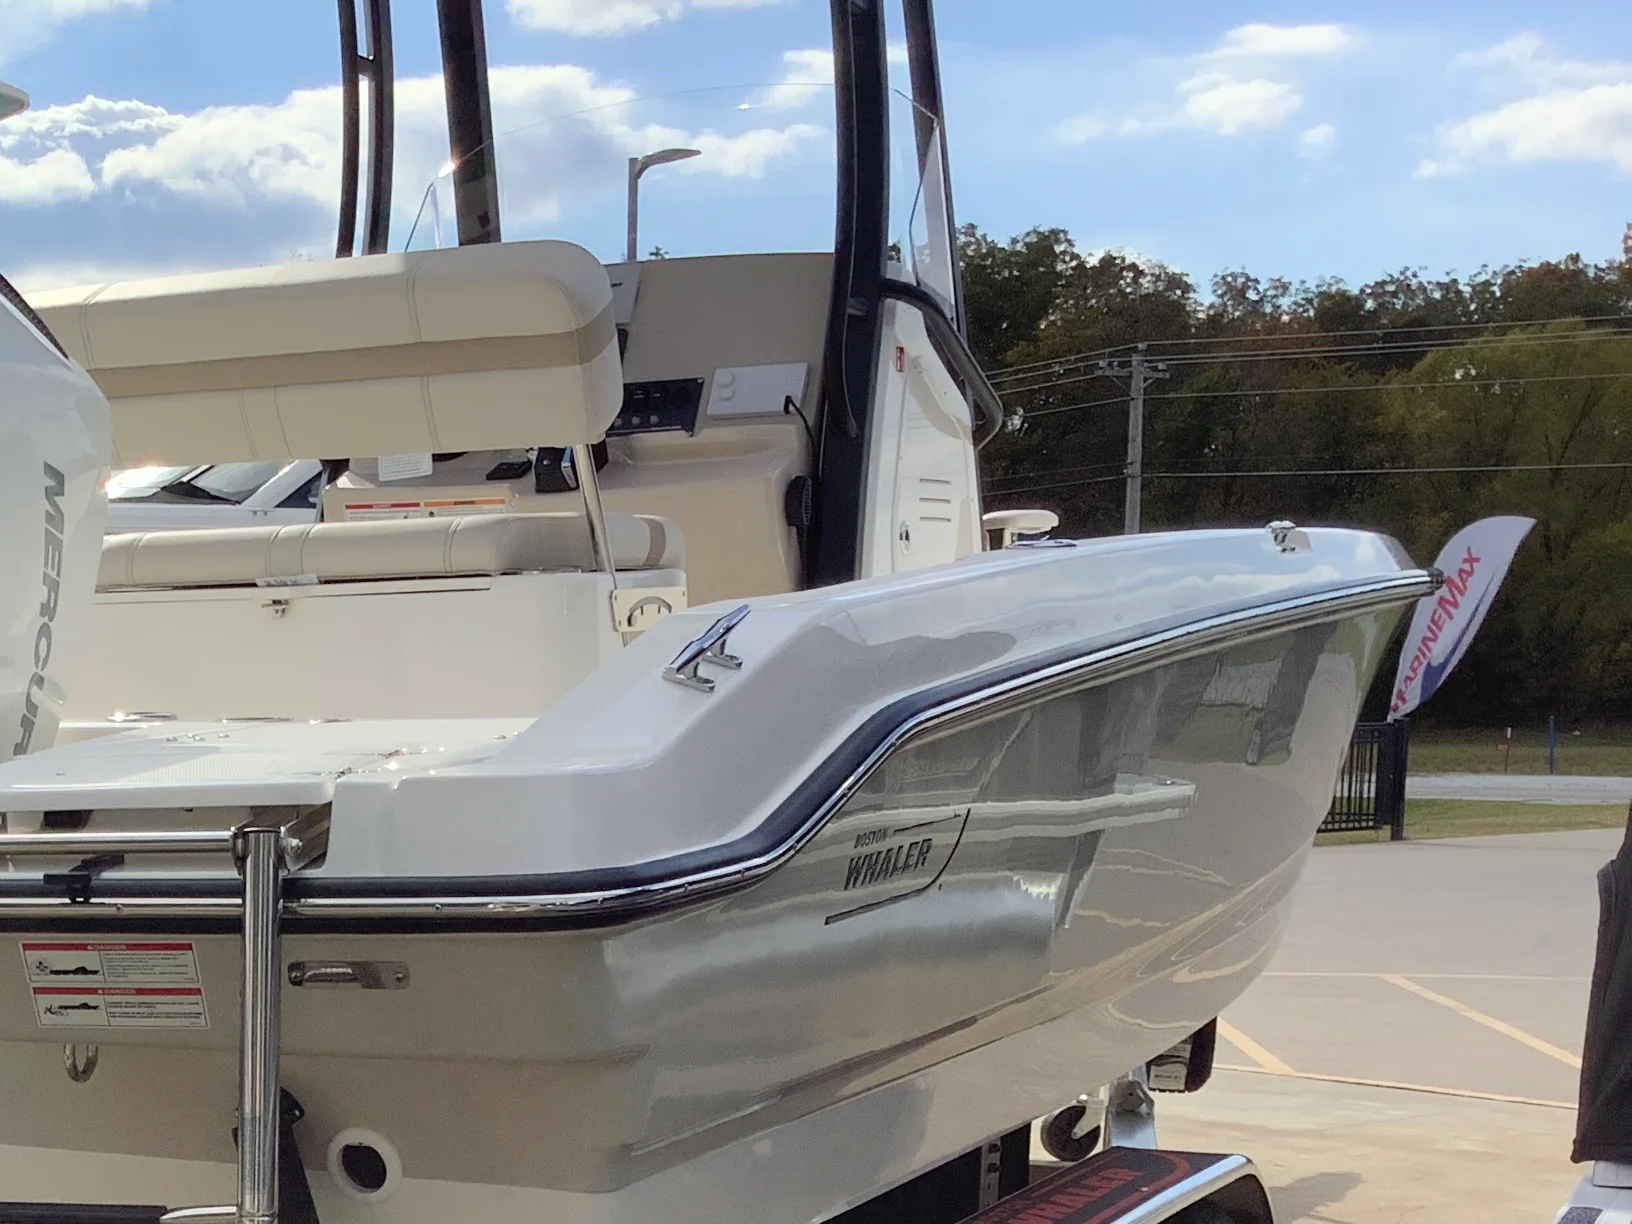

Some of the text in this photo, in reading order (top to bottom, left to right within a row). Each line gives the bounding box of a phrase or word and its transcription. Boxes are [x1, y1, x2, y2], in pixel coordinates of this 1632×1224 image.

[12, 460, 65, 757] MERCUR
[844, 838, 933, 891] WHALER
[854, 827, 889, 849] BOSTON
